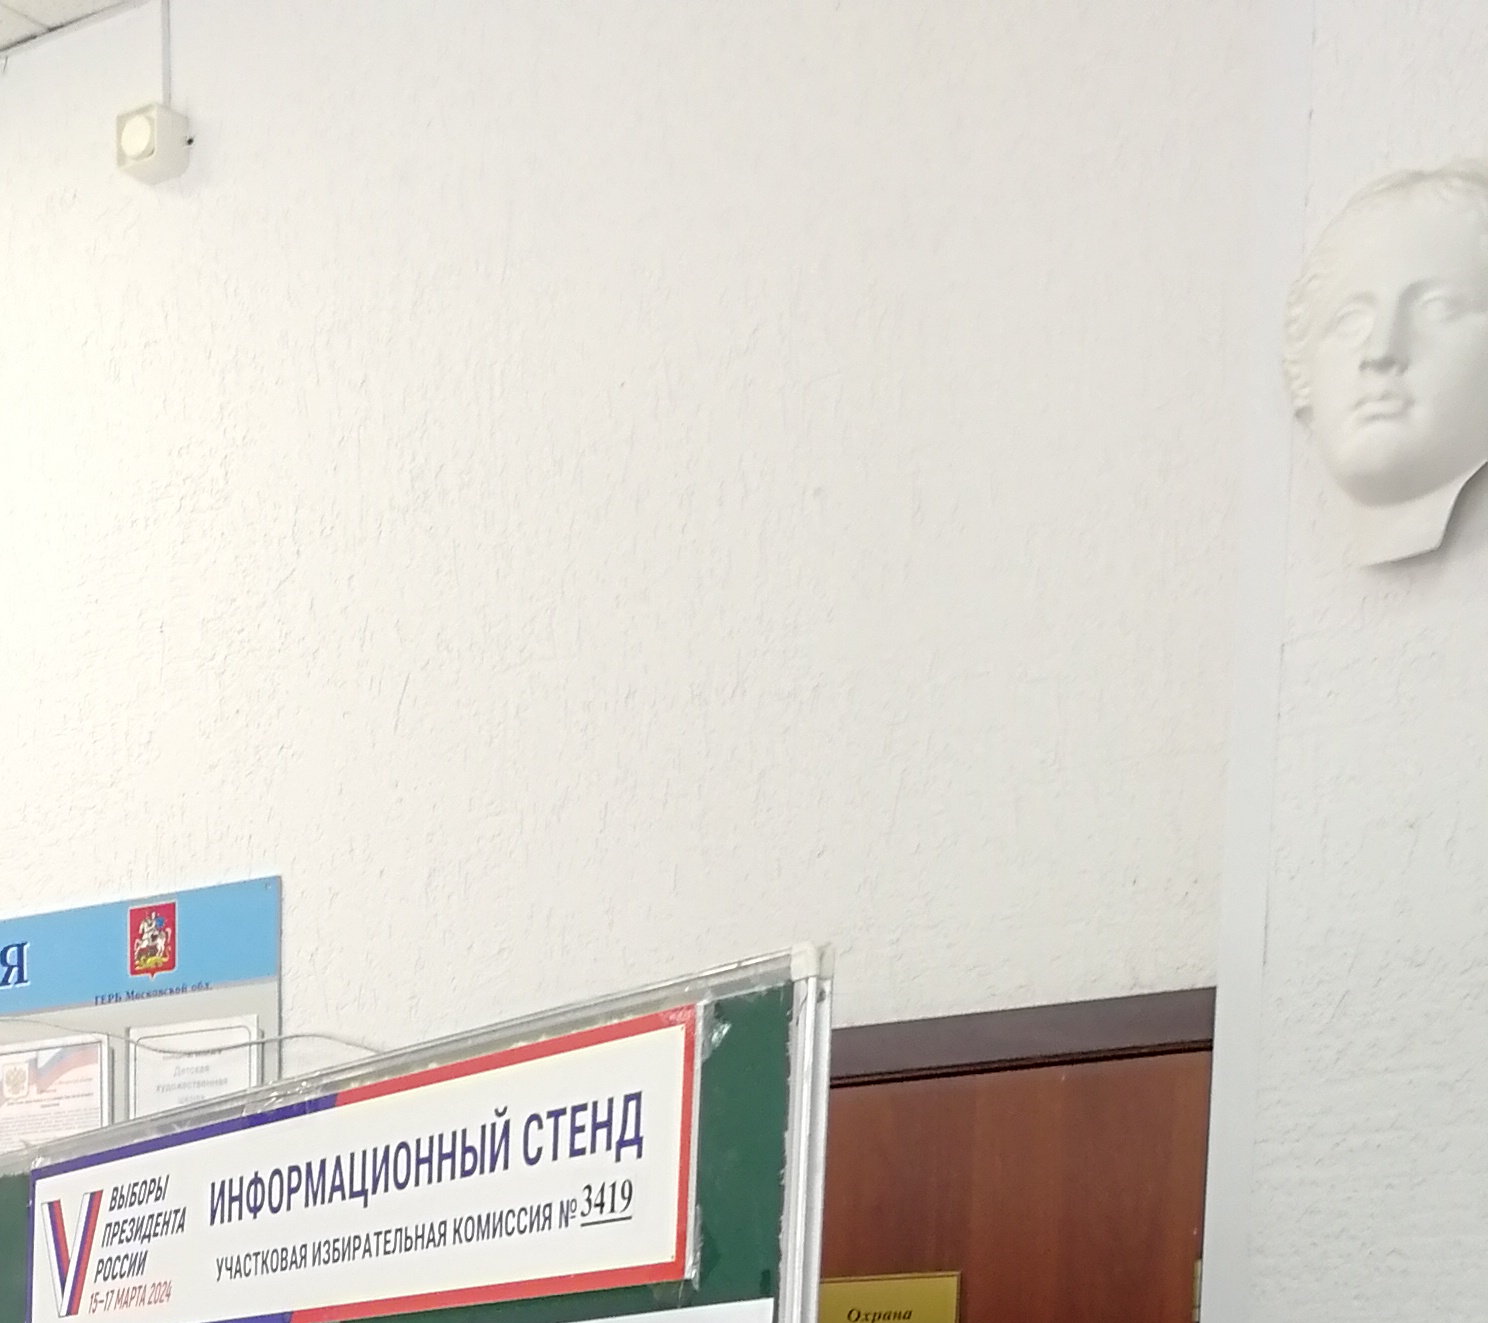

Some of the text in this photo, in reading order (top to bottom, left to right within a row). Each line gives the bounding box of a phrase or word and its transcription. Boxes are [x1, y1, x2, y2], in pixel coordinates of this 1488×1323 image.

[209, 1105, 511, 1227] ИНФОРМАЦИОННЫЙ
[522, 1090, 644, 1167] СТЕНД
[108, 1174, 170, 1212] ВЫБОРЫ
[100, 1206, 188, 1248] ПРЕЗИДЕНТА
[215, 1243, 308, 1283] УЧАСТКОВАЯ
[311, 1219, 448, 1269] ИЗБИРАТЕЛЬНАЯ
[452, 1201, 553, 1246] КОМИССИЯ
[580, 1178, 634, 1218] 3419
[93, 1250, 149, 1284] РОССИИ
[113, 1283, 147, 1312] МАРТА
[146, 1279, 173, 1306] 2024
